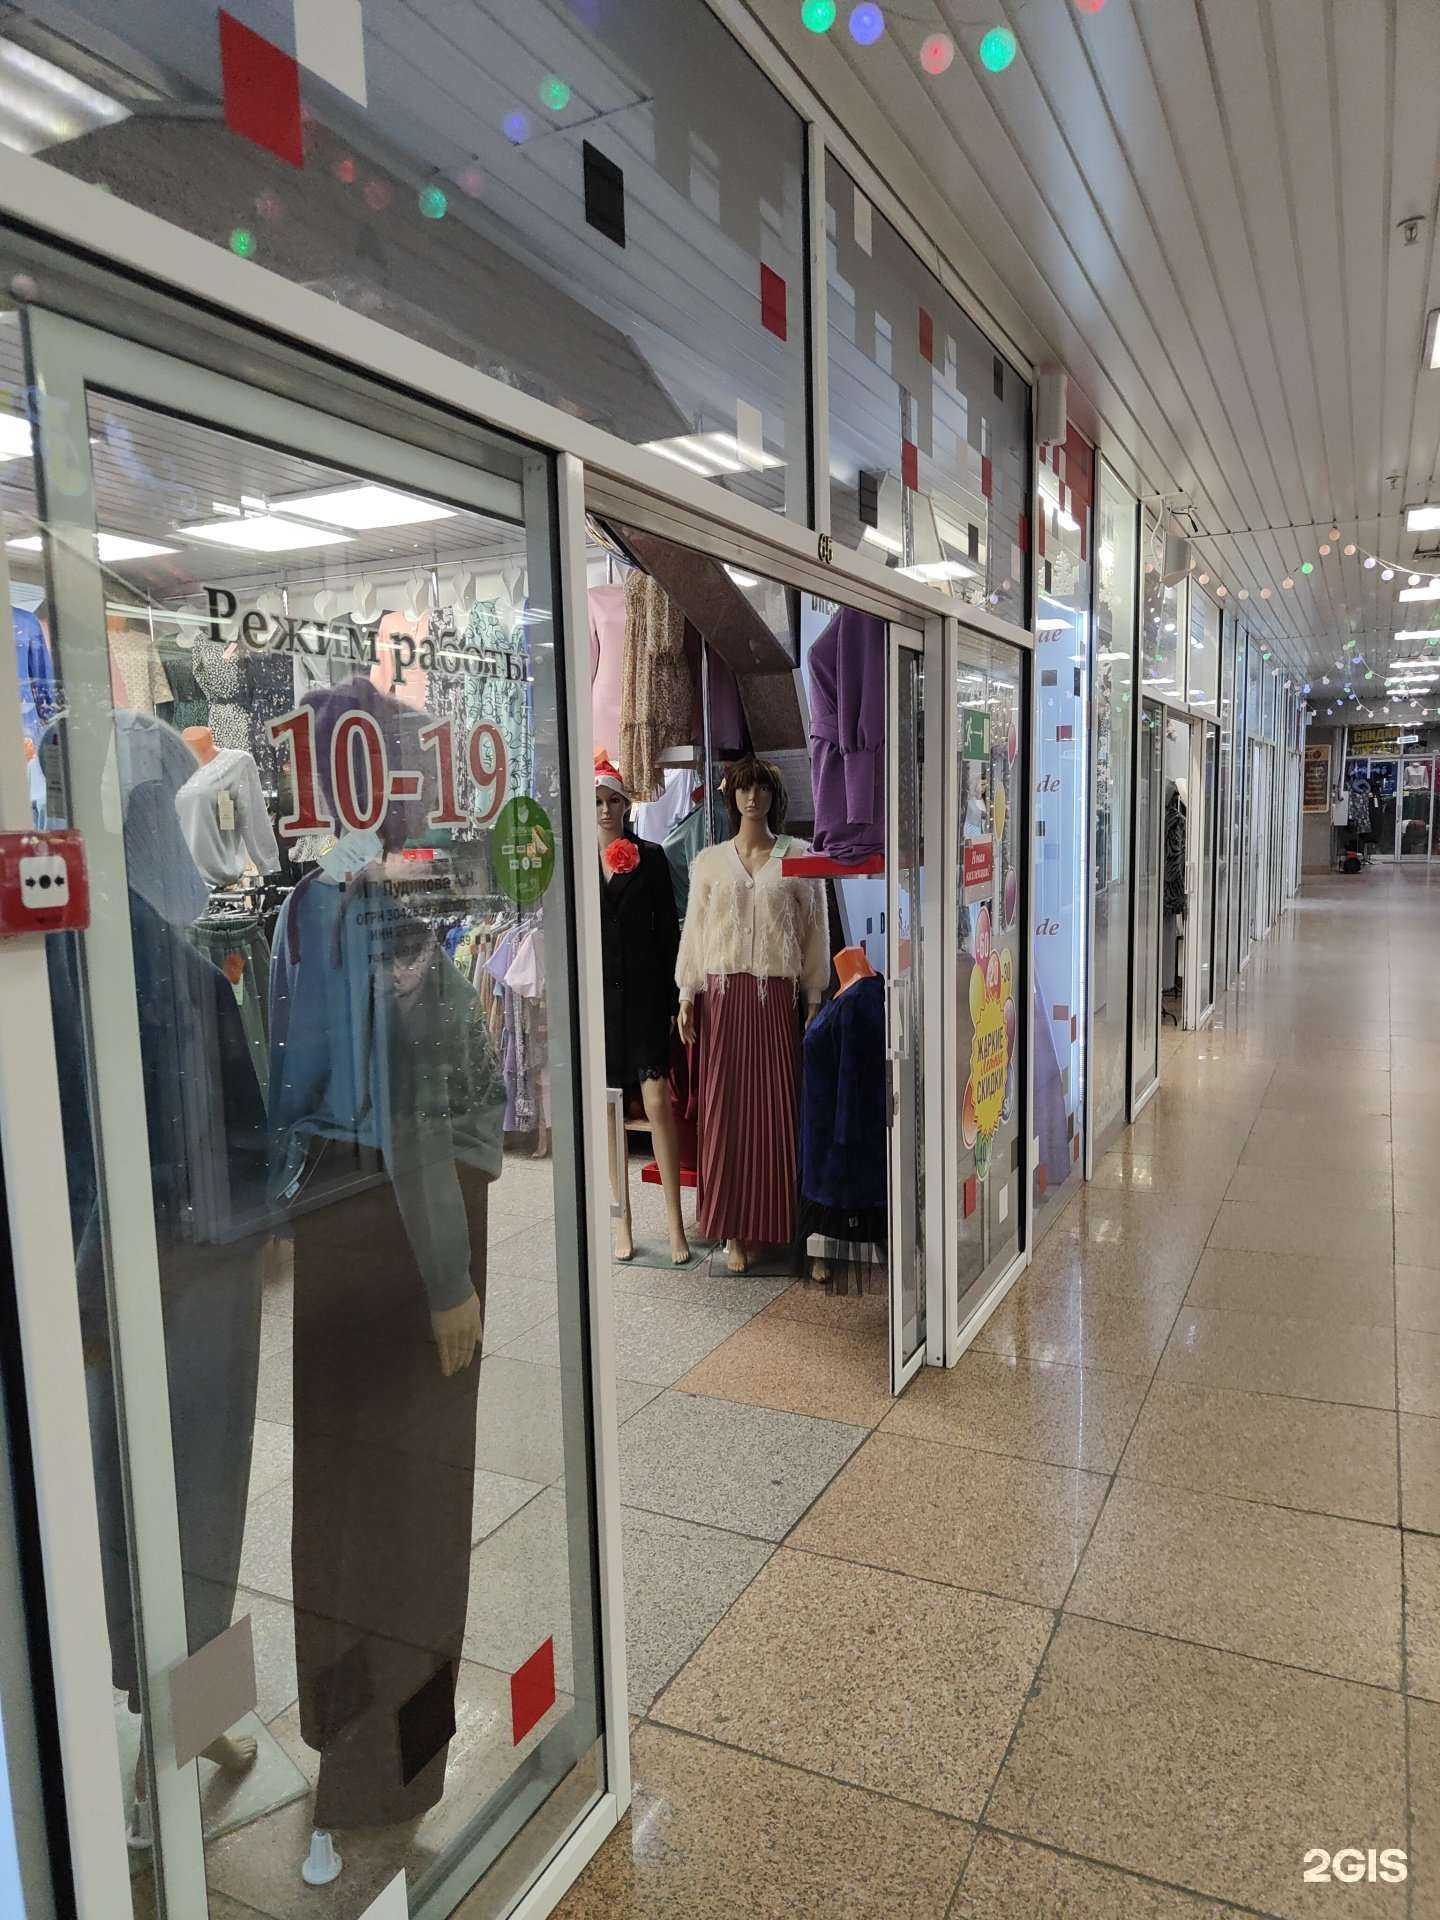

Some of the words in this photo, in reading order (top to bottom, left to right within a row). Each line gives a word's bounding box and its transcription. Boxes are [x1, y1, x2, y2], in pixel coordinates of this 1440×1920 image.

[817, 533, 833, 564] 65
[202, 586, 380, 664] Режим
[390, 630, 530, 685] работы
[266, 706, 508, 836] 10-19
[1035, 918, 1060, 936] de
[976, 1026, 1004, 1063] ЖАРКИЕ
[976, 1065, 1004, 1105] СКИДКИ
